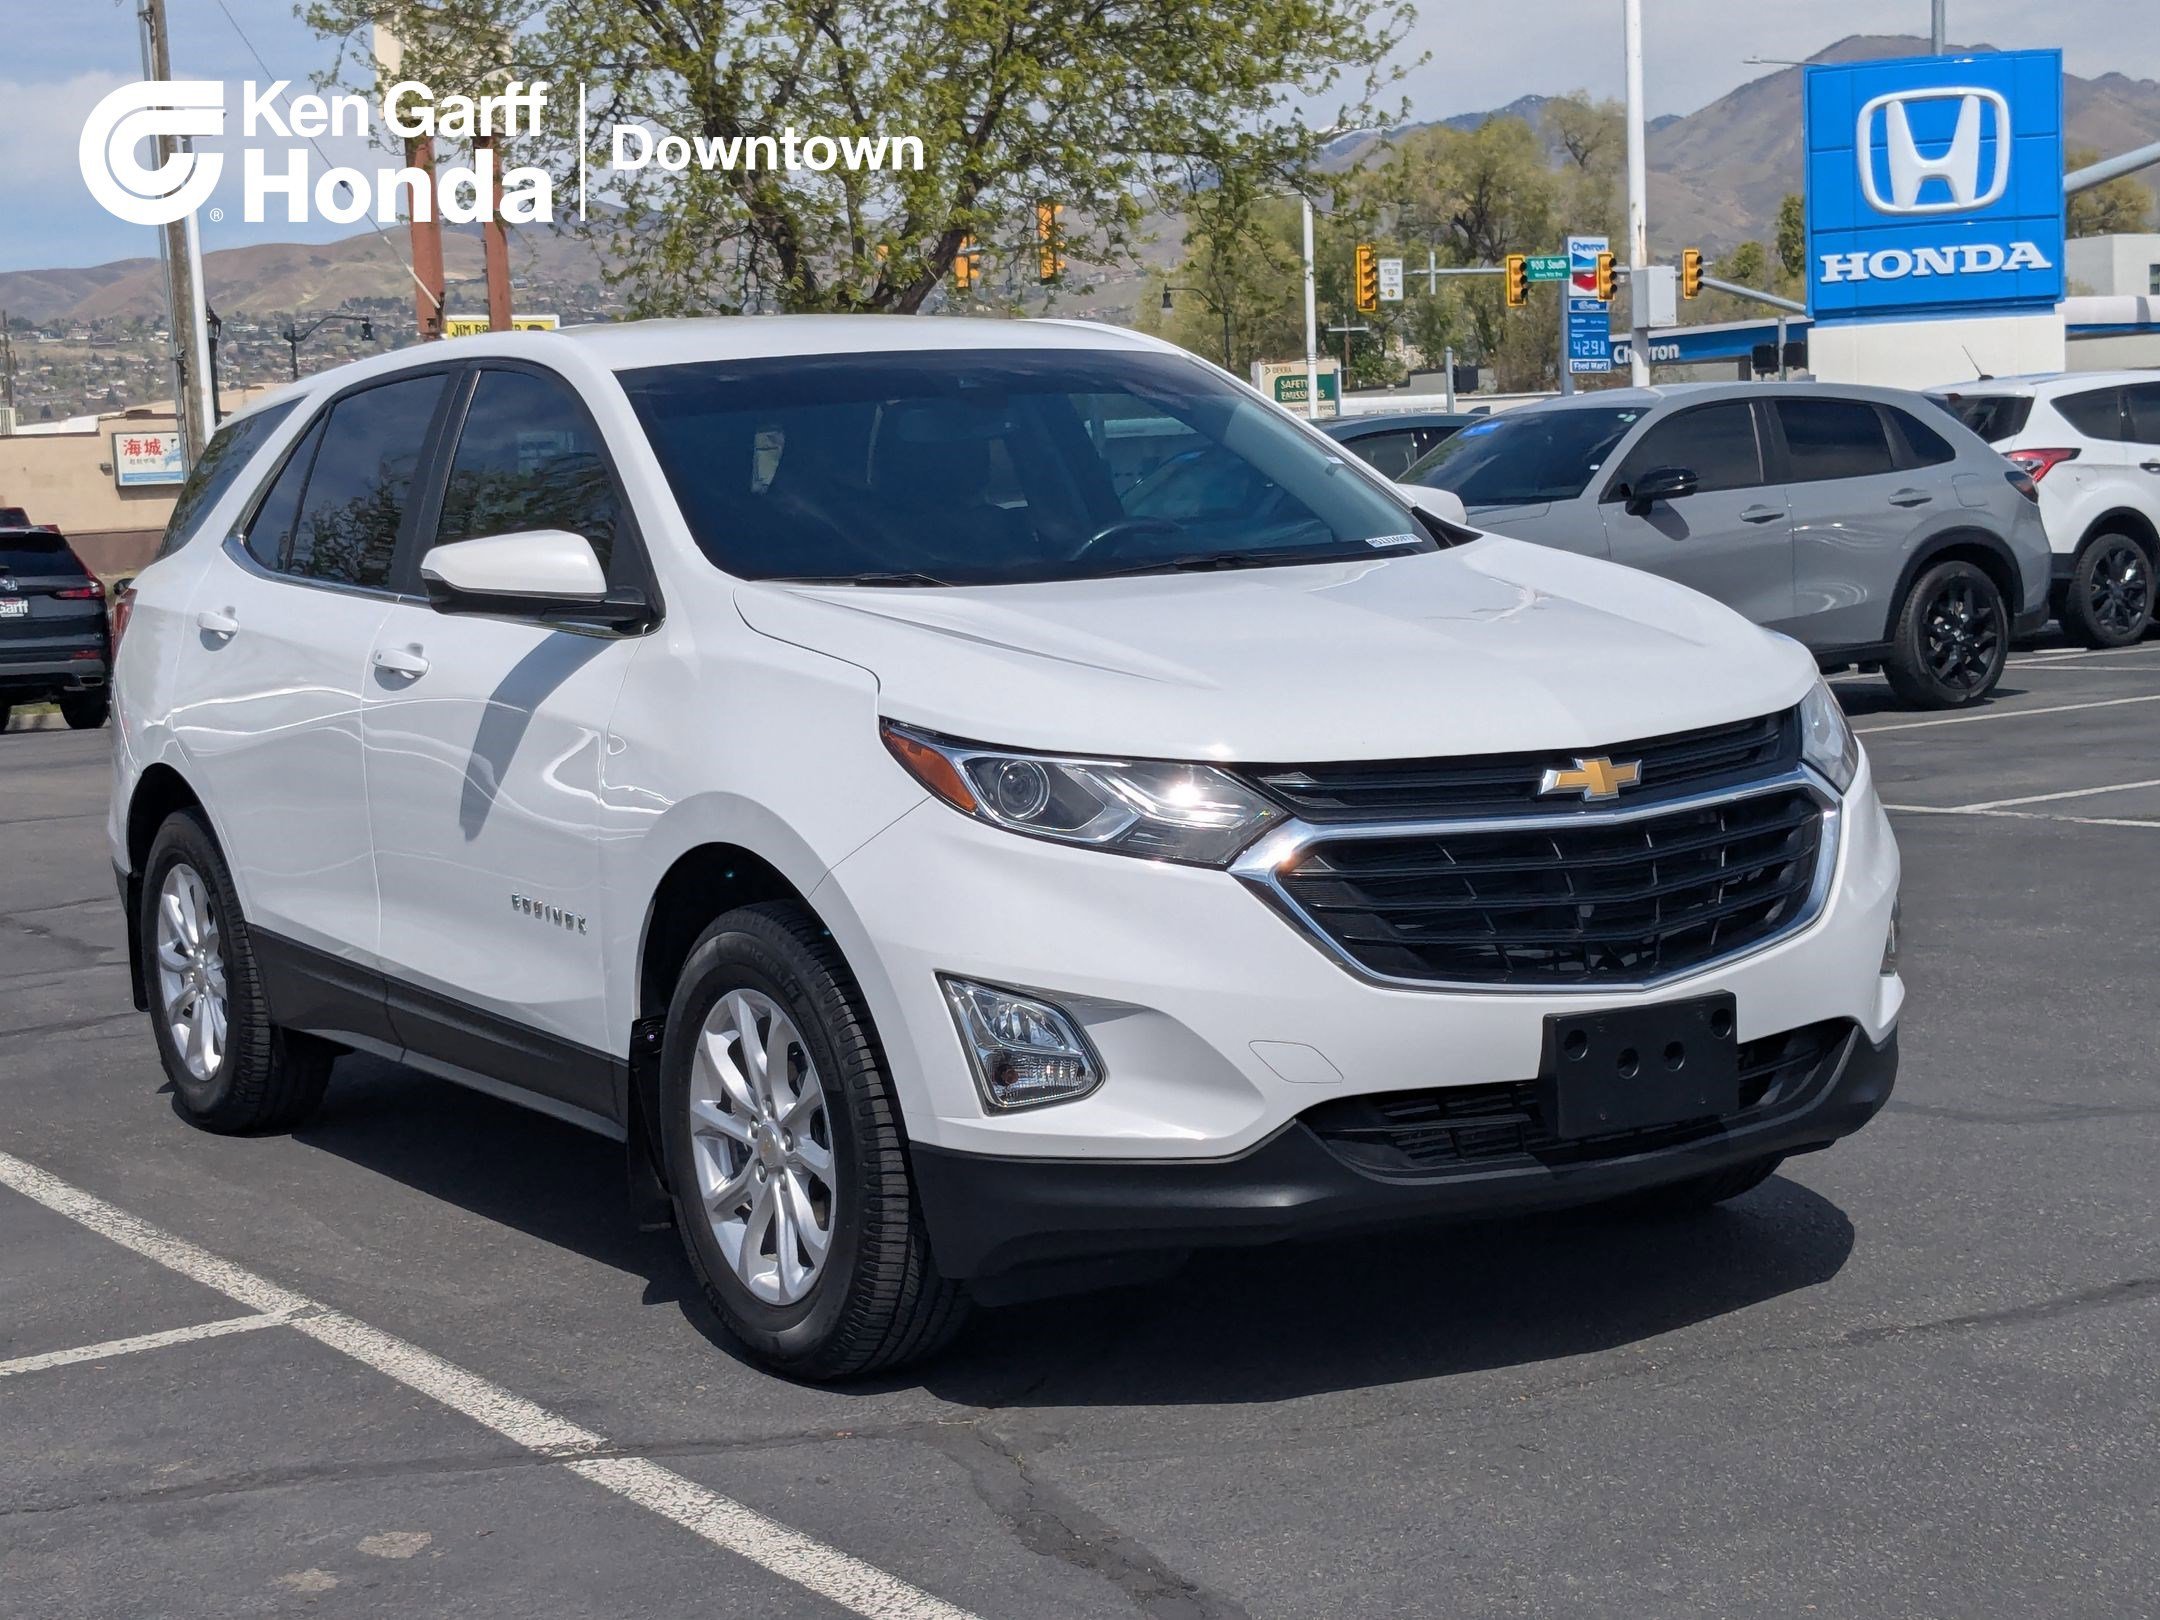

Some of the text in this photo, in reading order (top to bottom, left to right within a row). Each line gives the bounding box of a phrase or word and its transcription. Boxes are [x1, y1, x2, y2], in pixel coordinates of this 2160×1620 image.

[1571, 241, 1606, 252] Chevron
[1819, 241, 2053, 283] HONDA
[451, 324, 472, 338] JIM
[123, 437, 164, 457] 海城
[511, 891, 588, 936] EQUINOX
